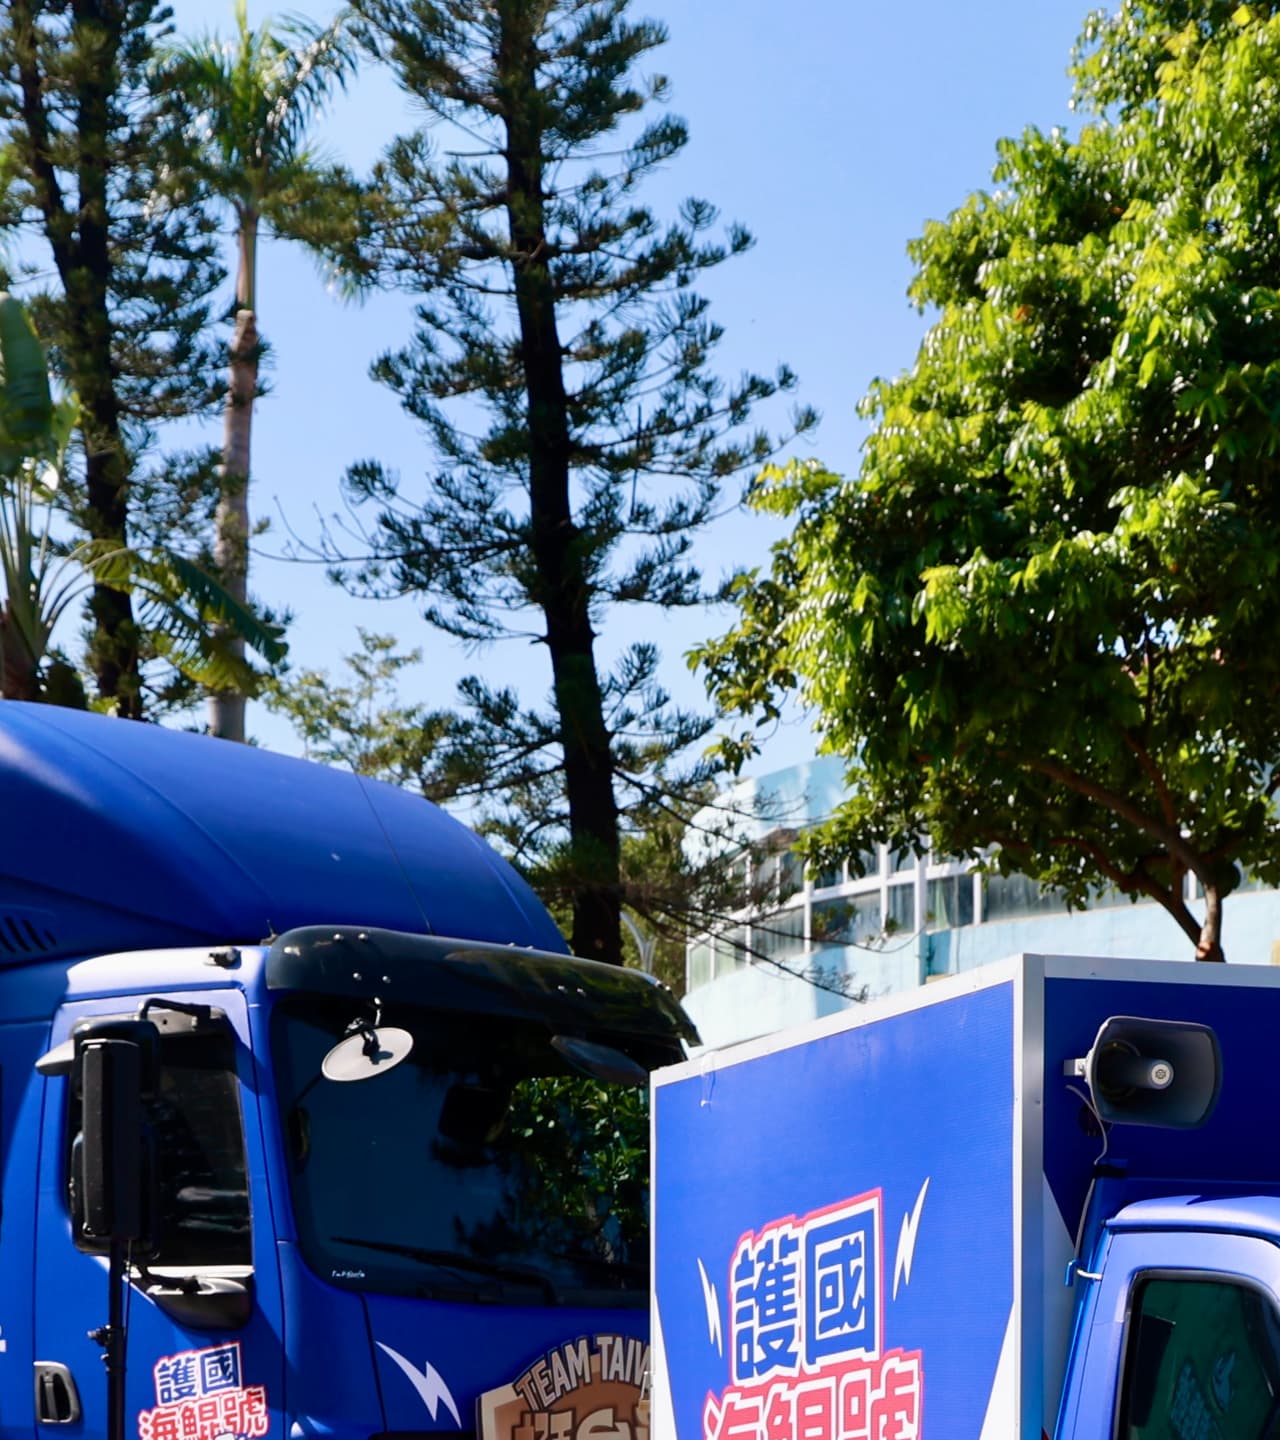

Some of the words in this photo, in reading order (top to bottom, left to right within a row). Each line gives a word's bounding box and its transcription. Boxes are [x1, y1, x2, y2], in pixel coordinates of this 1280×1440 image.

[730, 1193, 881, 1387] 護國
[154, 1343, 241, 1407] 護國
[515, 1338, 591, 1412] TEAM
[596, 1336, 650, 1390] TAIW
